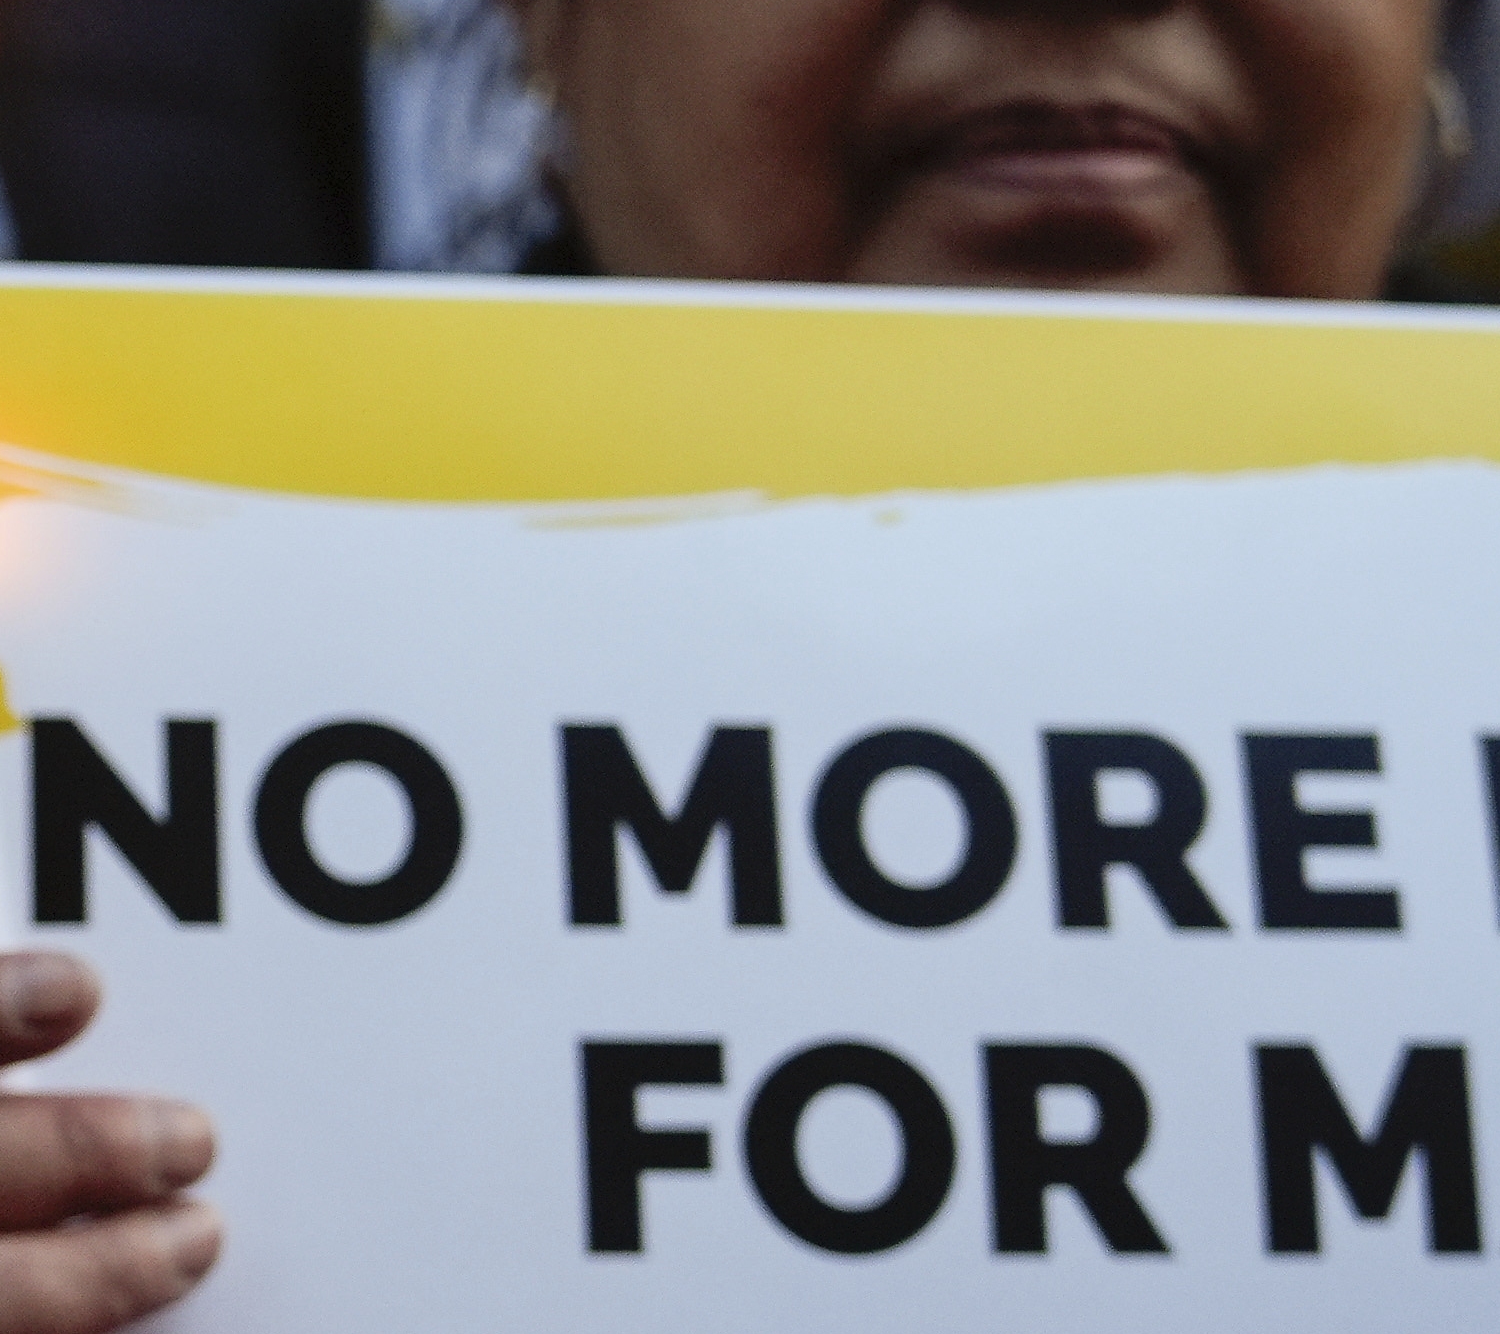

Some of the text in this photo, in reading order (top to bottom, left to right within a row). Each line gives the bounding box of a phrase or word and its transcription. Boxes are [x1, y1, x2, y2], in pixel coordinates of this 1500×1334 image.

[26, 717, 466, 929] NO
[558, 723, 1404, 933] MORE
[578, 1038, 1172, 1257] FOR
